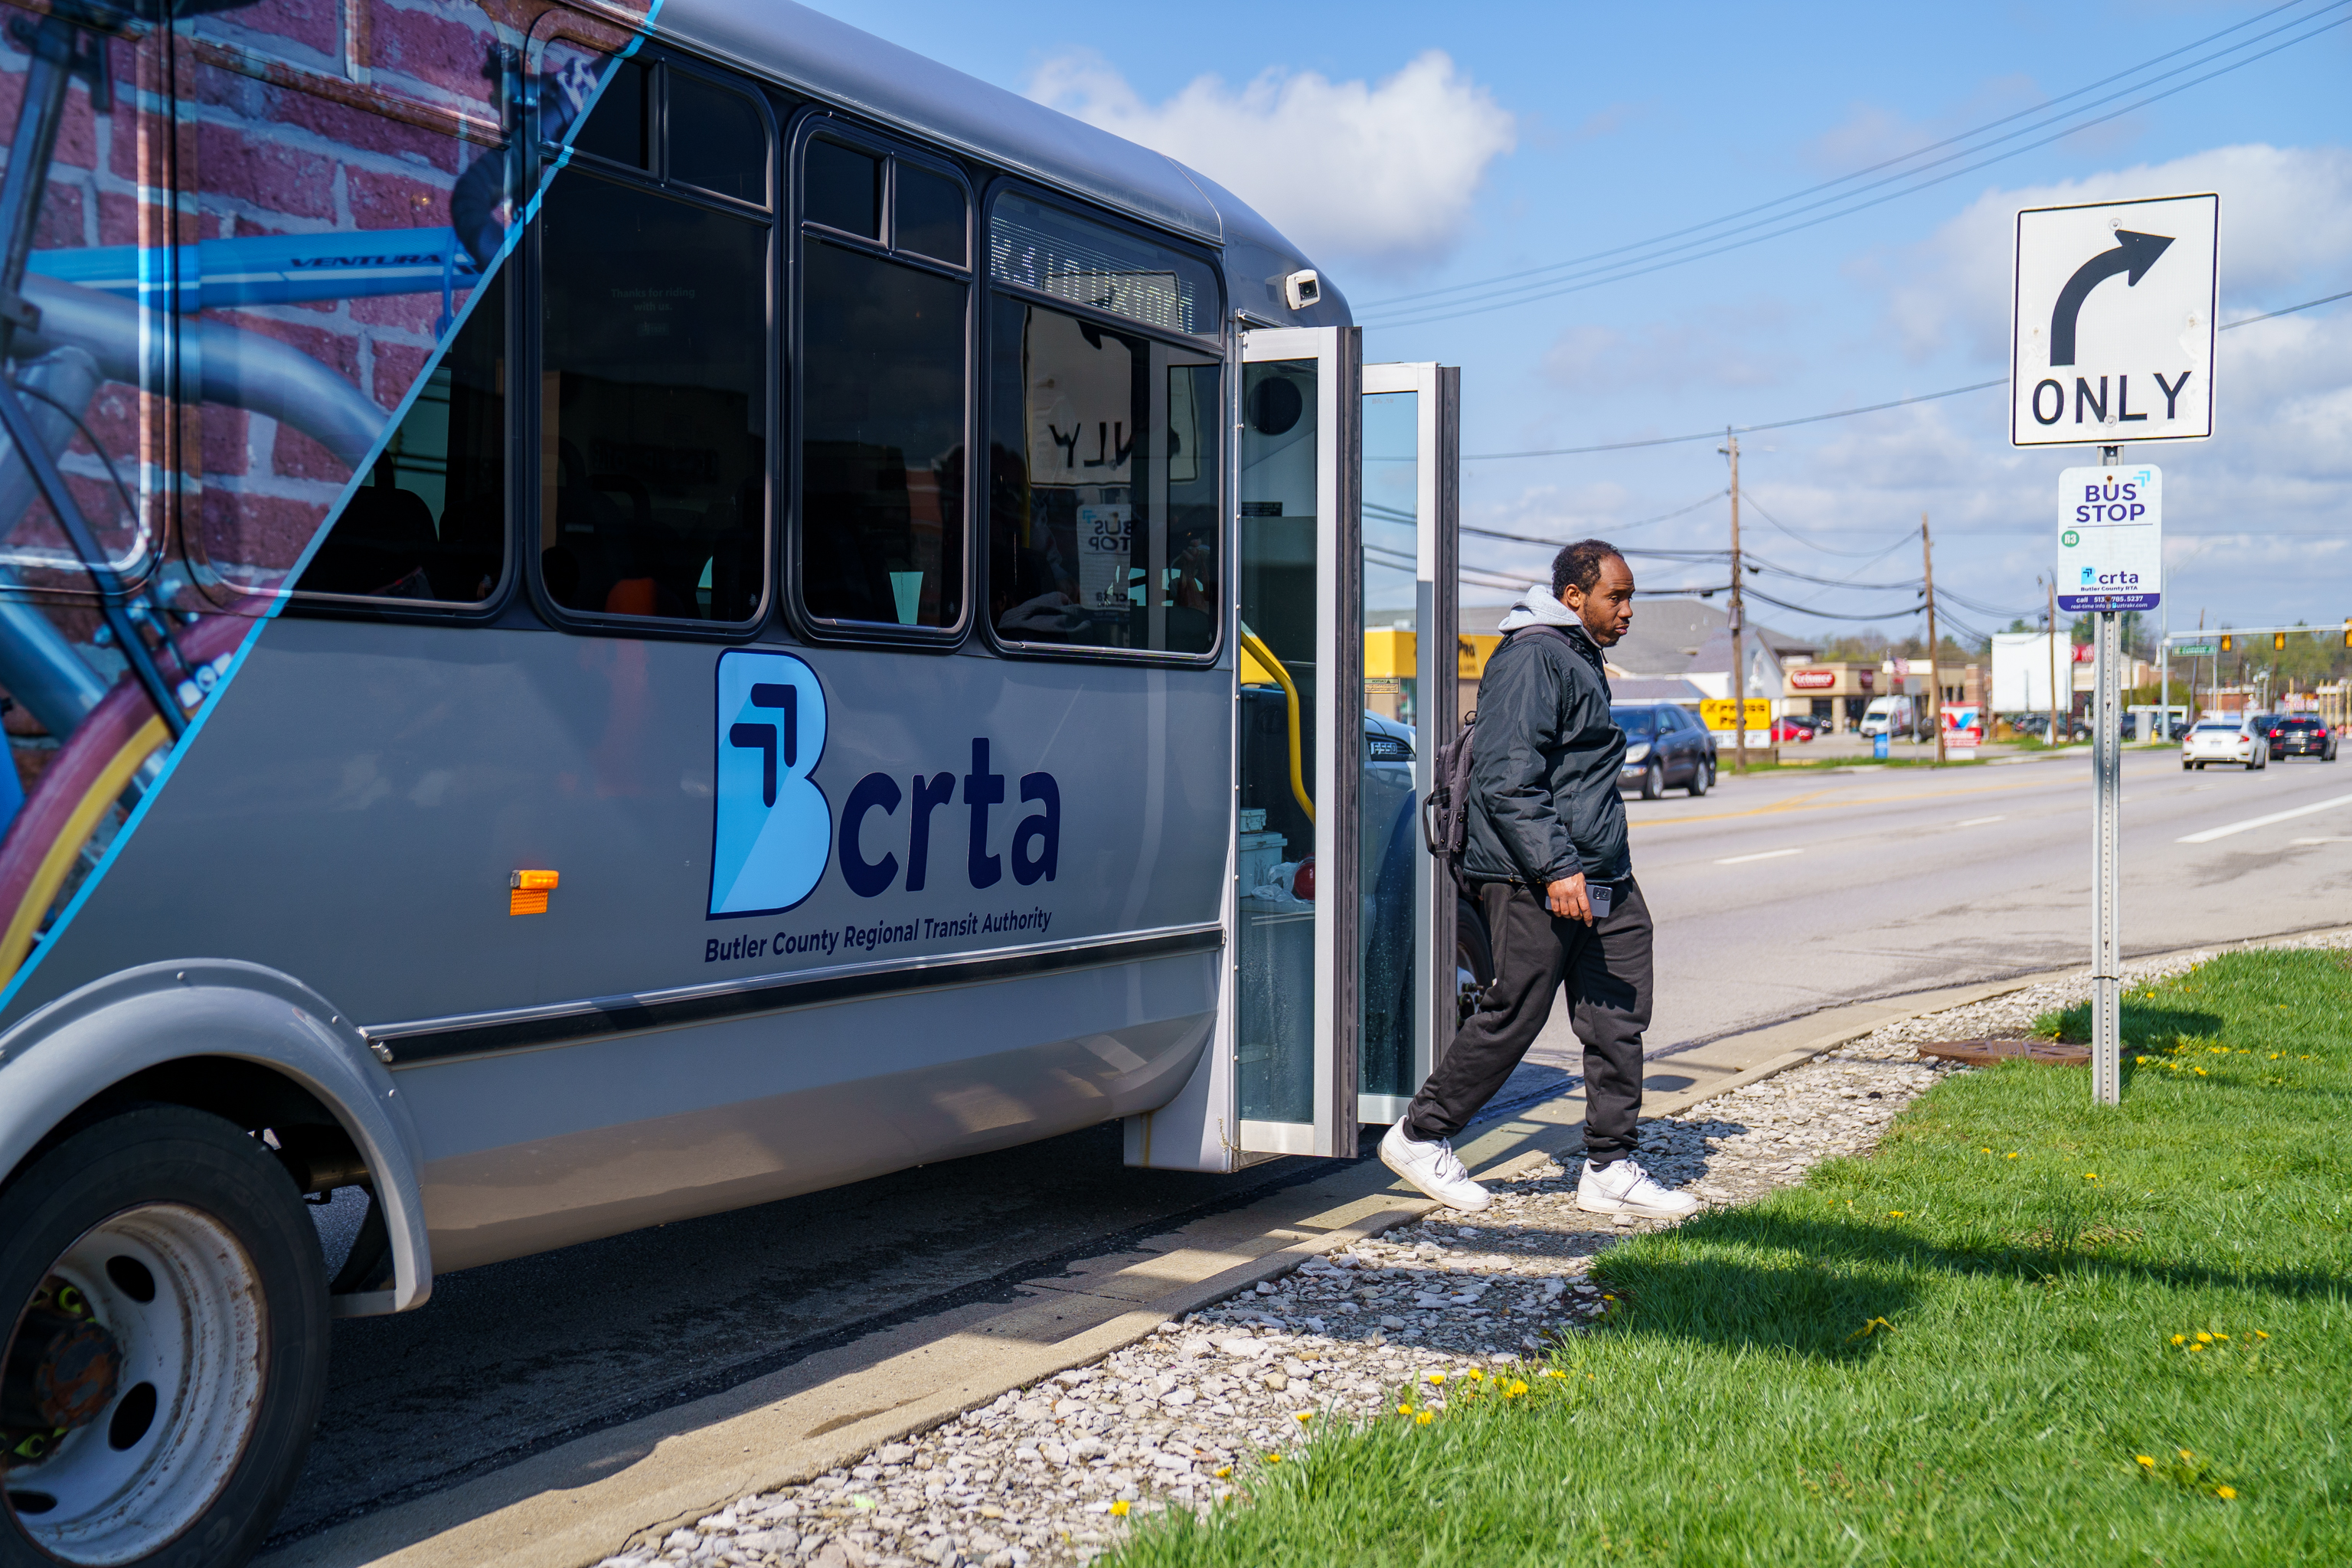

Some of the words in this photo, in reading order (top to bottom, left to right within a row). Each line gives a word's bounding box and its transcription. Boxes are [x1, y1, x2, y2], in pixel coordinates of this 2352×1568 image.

[289, 253, 442, 268] VENTURA
[610, 287, 646, 298] Thanks
[648, 286, 664, 297] for
[665, 286, 695, 299] riding
[633, 301, 656, 312] with
[2032, 371, 2193, 425] ONLY
[2085, 482, 2137, 503] BUS
[2076, 503, 2145, 523] STOP
[2063, 534, 2077, 544] R3
[704, 936, 768, 963] Butler
[772, 927, 840, 956] County
[843, 919, 920, 952] Regional
[924, 914, 978, 940] Transit
[982, 906, 1053, 934] Authority
